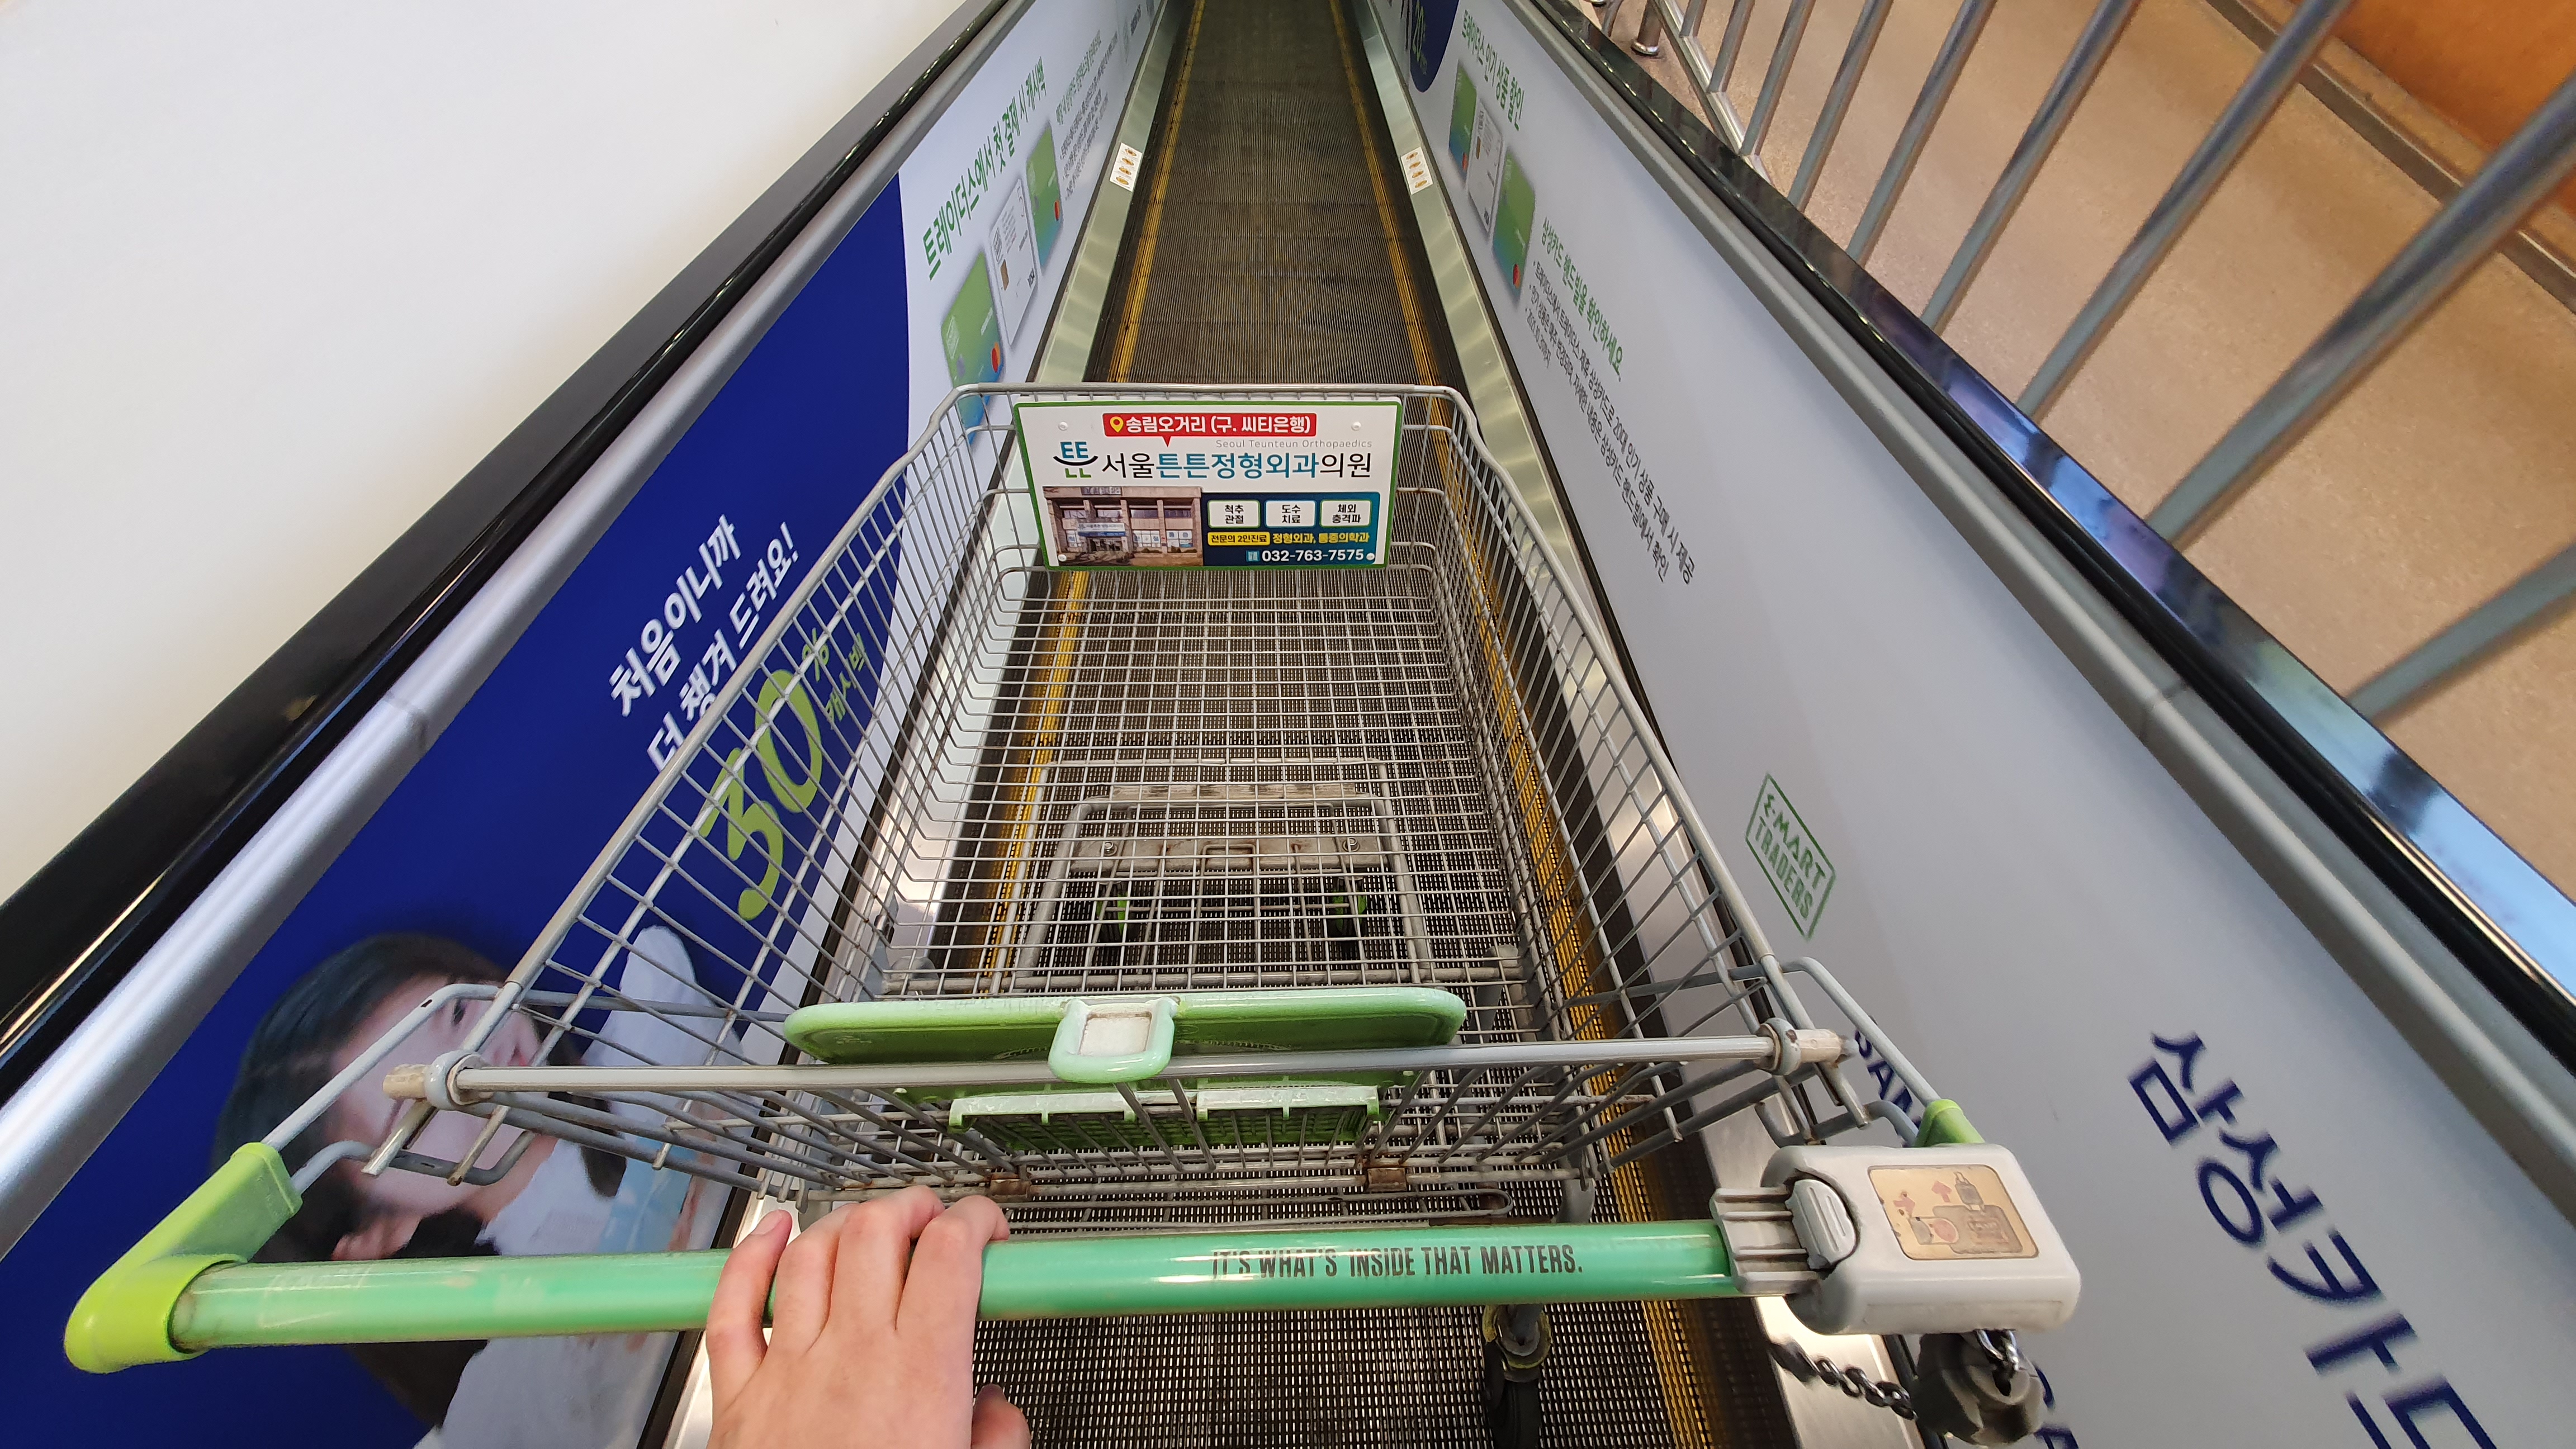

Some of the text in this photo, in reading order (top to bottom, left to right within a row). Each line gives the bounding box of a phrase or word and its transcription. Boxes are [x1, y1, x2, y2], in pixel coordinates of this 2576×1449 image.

[1484, 42, 1498, 87] 인기
[1495, 59, 1510, 110] 상품
[1508, 76, 1525, 131] 할인
[922, 55, 1047, 281] 트레이더스에서 첫 결제 시 캐시백
[1541, 217, 1564, 268] 삼성카드
[1562, 254, 1588, 316] 핸드빌을
[1126, 415, 1311, 434] 송림오거리 (구. 씨티은행)
[1216, 439, 1372, 449] Seoul Teunteun Orthopaedics
[1102, 452, 1371, 480] 서울튼튼정형외과의원
[1589, 368, 1615, 428] 삼성카드로
[1626, 442, 1641, 481] 인기
[1639, 468, 1655, 506] 상품
[1653, 495, 1670, 538] 구매
[1667, 527, 1679, 554] 시
[1676, 541, 1695, 585] 제공
[1224, 504, 1244, 514] 척추
[1225, 514, 1244, 524] 관절
[1281, 504, 1301, 514] 도수
[1281, 514, 1301, 524] 치료
[1332, 514, 1362, 524] 충격파
[1337, 504, 1357, 513] 체외
[1600, 433, 1624, 487] 삼성카드
[1652, 540, 1670, 583] 확인
[1211, 534, 1267, 543] 전문의 2인진료
[1262, 549, 1365, 562] 032-763-7575
[608, 514, 741, 718] 처음이니까
[647, 521, 799, 774] 더 챙겨 드려요!
[1755, 815, 1813, 920] TRADERS
[1213, 1244, 1583, 1278] IT'S WHAT'S INSIDE THAT MATTERS.
